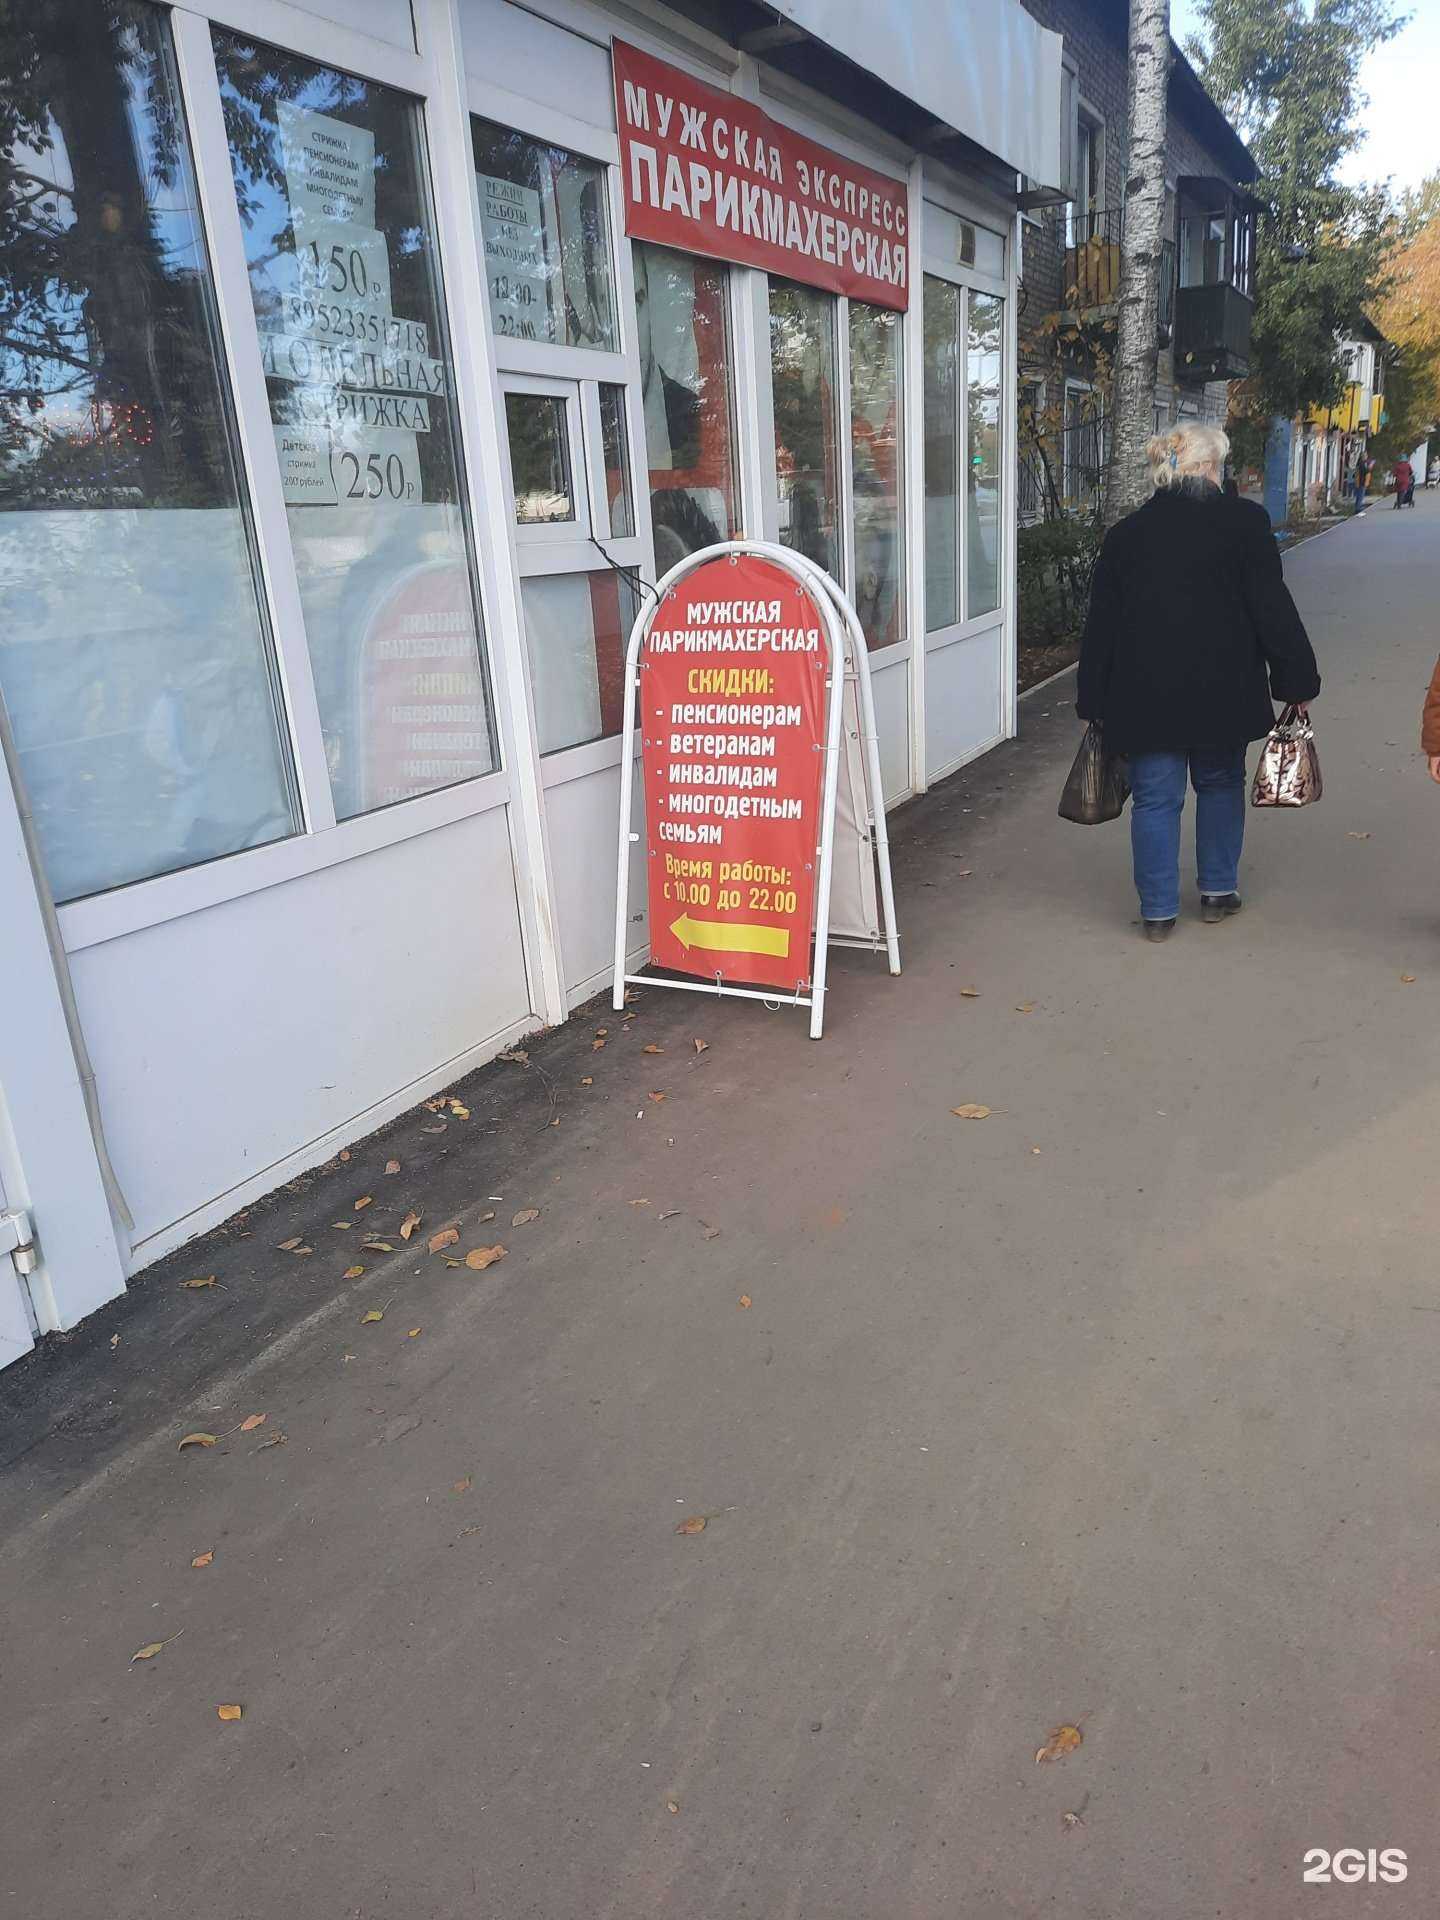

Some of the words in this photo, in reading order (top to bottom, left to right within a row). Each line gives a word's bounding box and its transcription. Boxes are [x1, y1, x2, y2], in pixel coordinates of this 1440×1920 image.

[311, 131, 349, 153] СТРИЖКА
[303, 146, 360, 172] ПЕНСИОНЕРАМ
[623, 79, 783, 185] МУЖСКАЯ
[796, 159, 906, 237] ЭКСПРЕСС
[308, 166, 359, 189] ИНВАЛИДАМ
[486, 200, 529, 225] РАБОТЫ
[629, 140, 906, 289] ПАРИКМАХЕРСКАЯ
[686, 600, 782, 625] МУЖСКАЯ
[649, 628, 819, 653] ПАРИКМАХЕРСКАЯ
[687, 668, 775, 698] СКИДКИ:
[671, 703, 802, 730] пенсионерам
[669, 733, 776, 759] ветеранам
[668, 763, 778, 790] инвалидам
[668, 793, 803, 820] многодетным
[658, 821, 723, 845] семьям
[664, 852, 713, 879] Время
[719, 860, 793, 886] работы:
[673, 880, 711, 906] 10.00
[716, 889, 742, 911] до
[748, 887, 798, 914] 22.00
